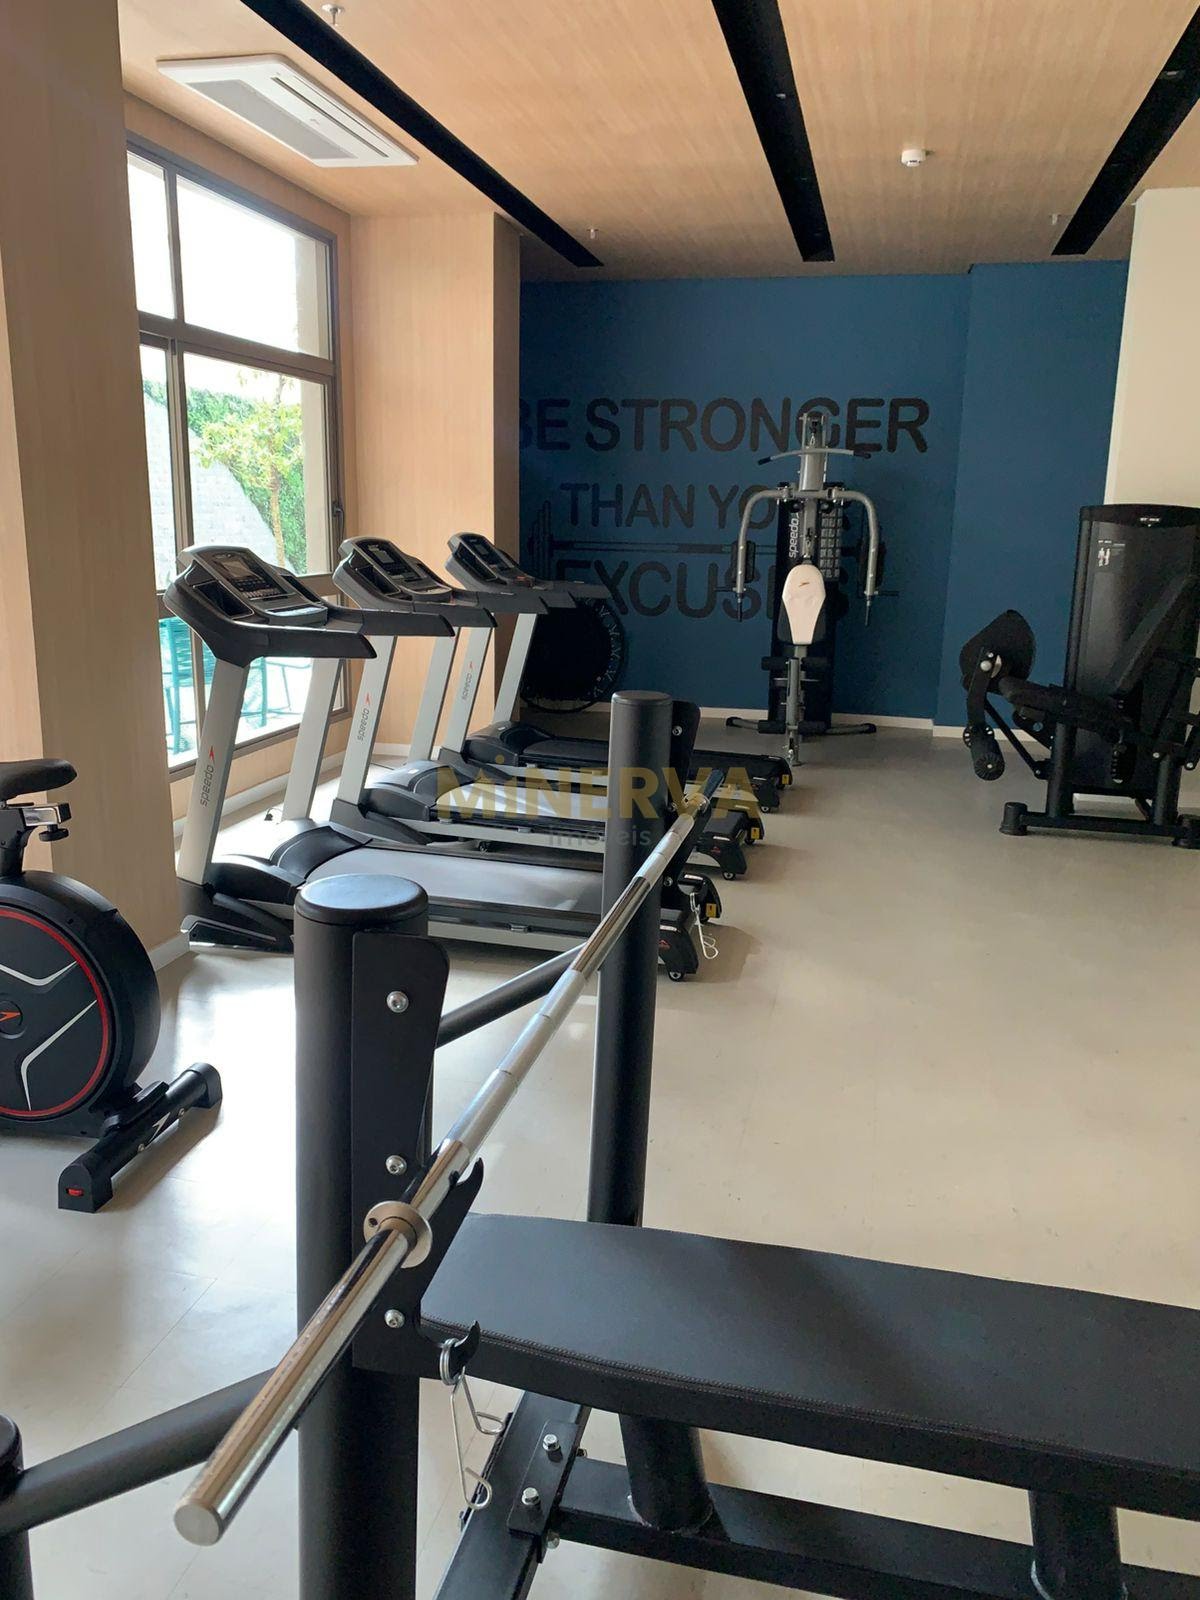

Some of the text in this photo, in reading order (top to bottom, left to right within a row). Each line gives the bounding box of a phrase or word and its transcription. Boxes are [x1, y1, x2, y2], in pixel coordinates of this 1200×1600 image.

[585, 396, 930, 453] STRONGER
[559, 482, 695, 529] THAN
[789, 517, 800, 559] speedo
[357, 706, 370, 742] speedo
[200, 764, 215, 808] speedo
